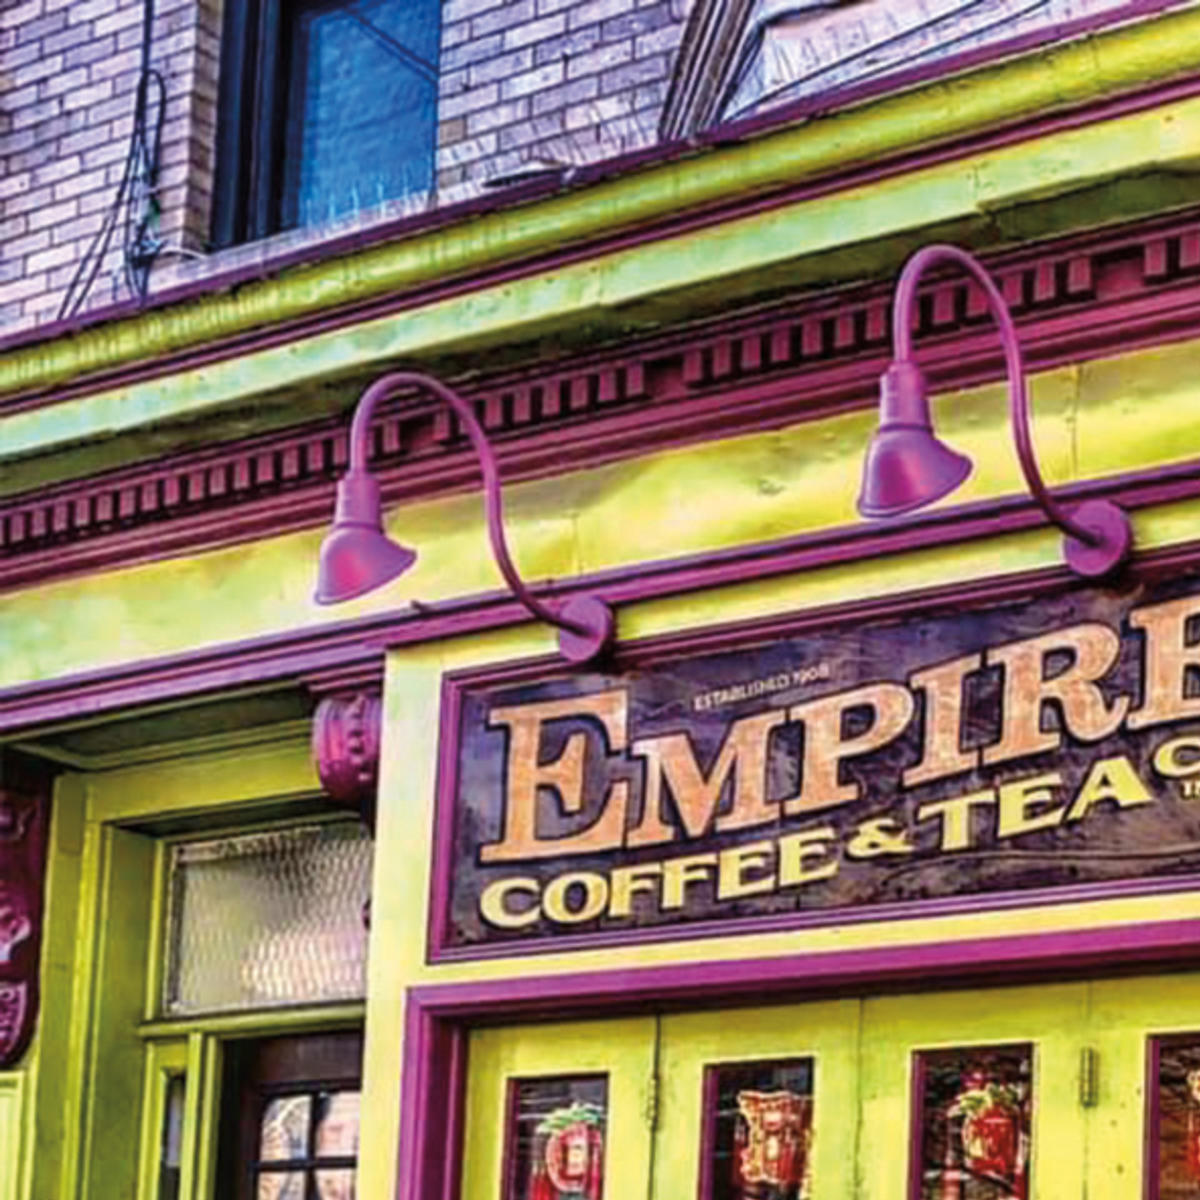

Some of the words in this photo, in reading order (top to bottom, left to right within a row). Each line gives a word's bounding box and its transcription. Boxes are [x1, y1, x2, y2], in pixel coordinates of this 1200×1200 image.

[693, 672, 791, 711] ESTABLISHED
[479, 827, 838, 929] COFFEE
[844, 817, 915, 859] &
[917, 756, 1153, 852] TEA
